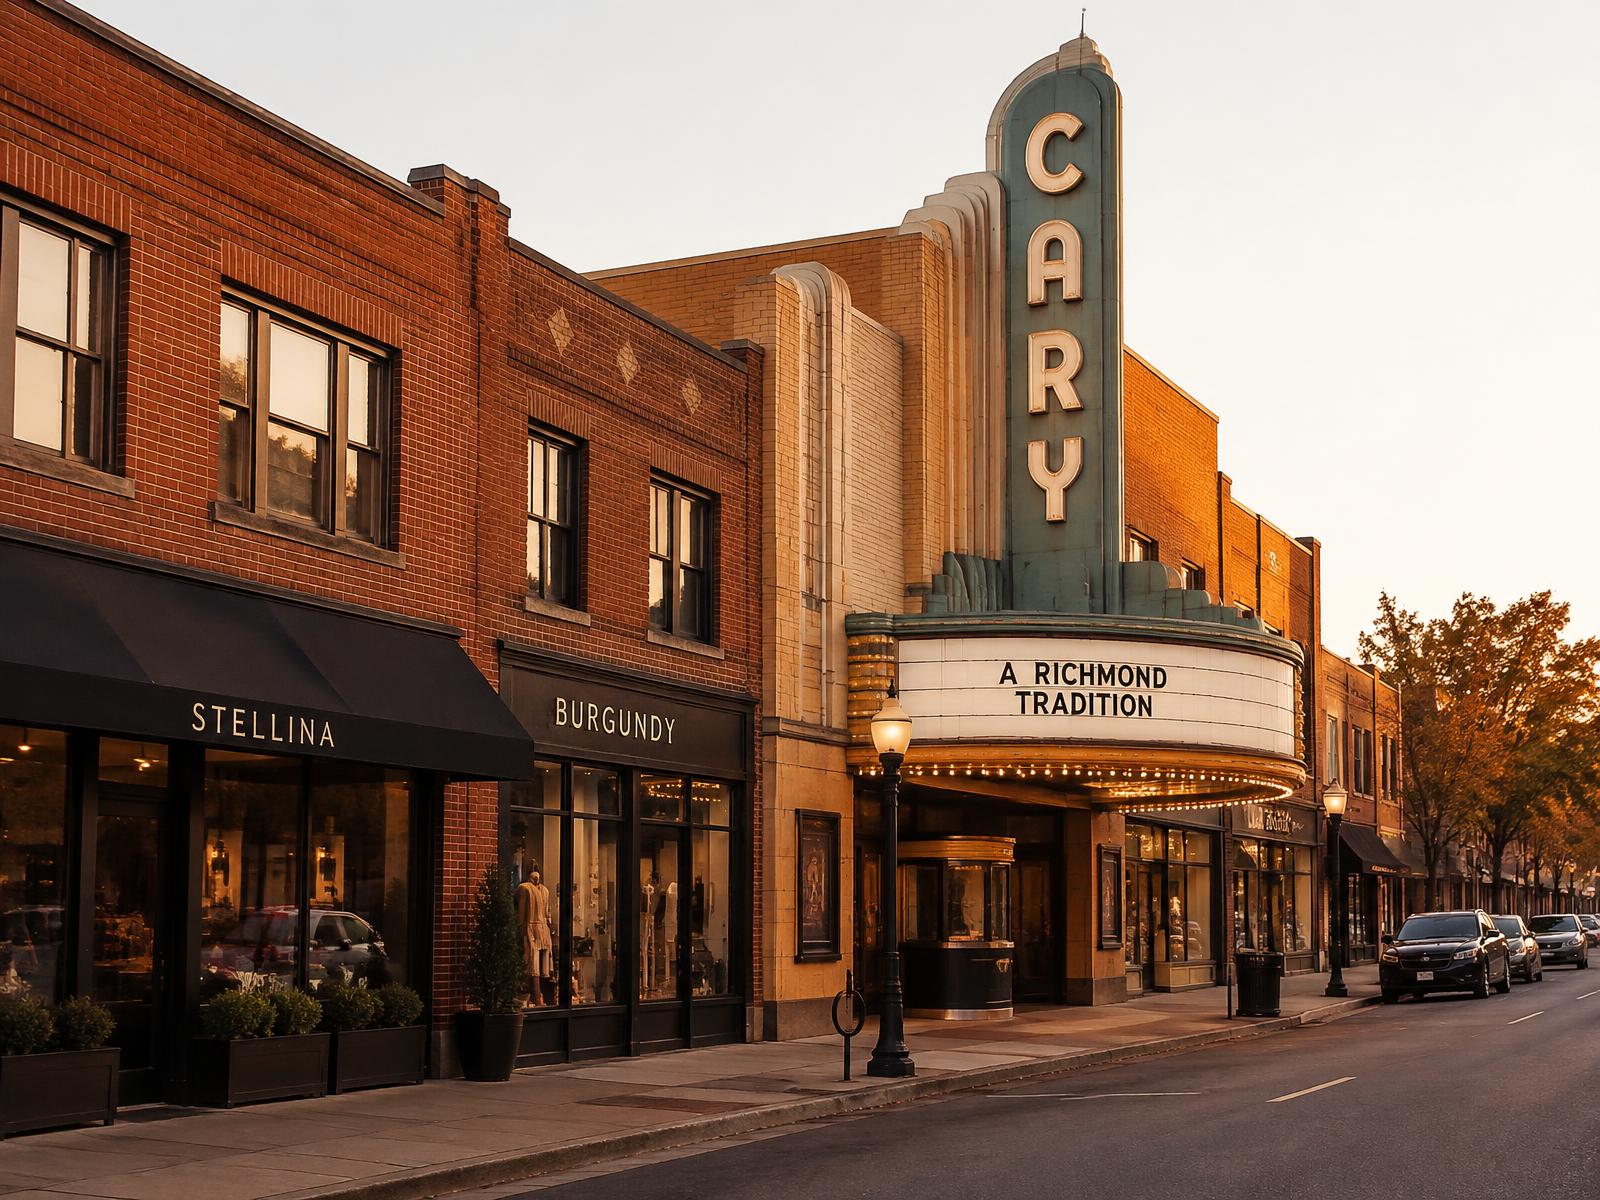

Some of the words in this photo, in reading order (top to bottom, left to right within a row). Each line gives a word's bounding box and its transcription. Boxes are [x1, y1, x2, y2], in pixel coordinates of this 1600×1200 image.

[1025, 112, 1085, 523] CARY
[999, 662, 1018, 685] A
[1035, 662, 1167, 688] RICHMOND
[192, 702, 336, 748] STELLINA
[555, 696, 677, 745] BURGUNDY
[1015, 691, 1152, 717] TRADITION
